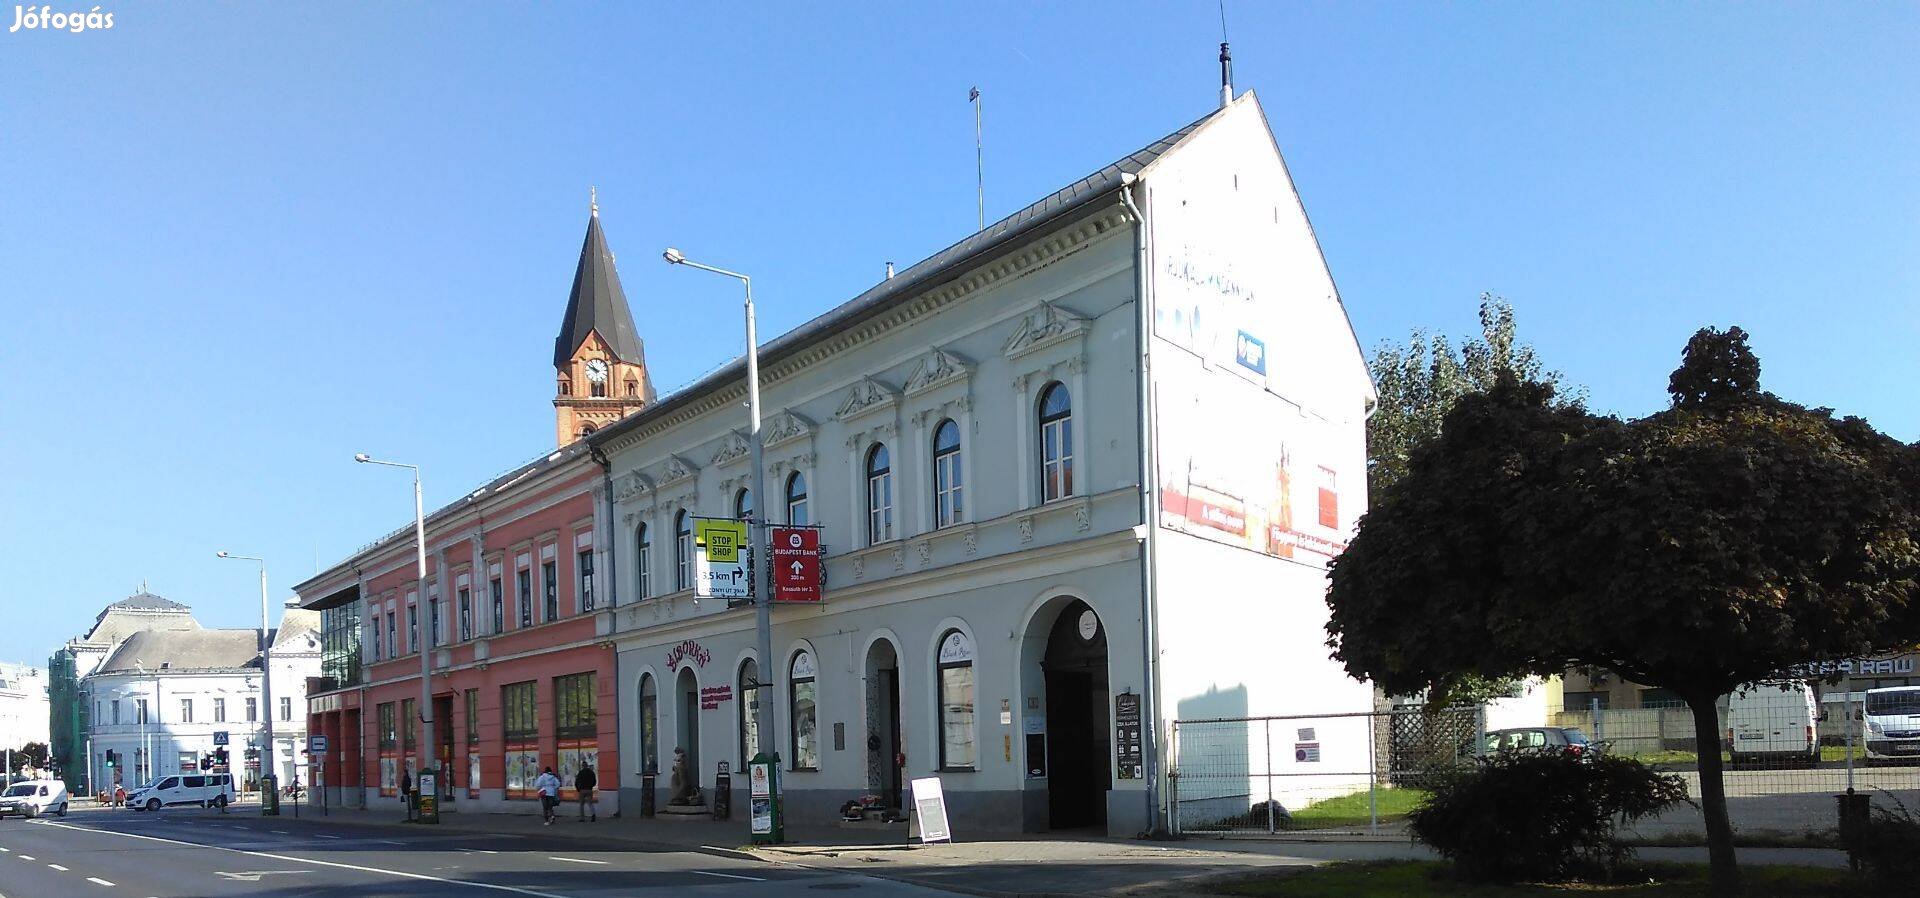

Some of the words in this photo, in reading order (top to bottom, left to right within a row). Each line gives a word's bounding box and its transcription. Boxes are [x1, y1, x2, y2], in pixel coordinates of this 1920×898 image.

[712, 536, 732, 545] STOP
[712, 547, 732, 556] SHOP
[775, 548, 802, 556] BUDAPEST
[716, 571, 730, 580] km
[1860, 660, 1914, 674] RAW
